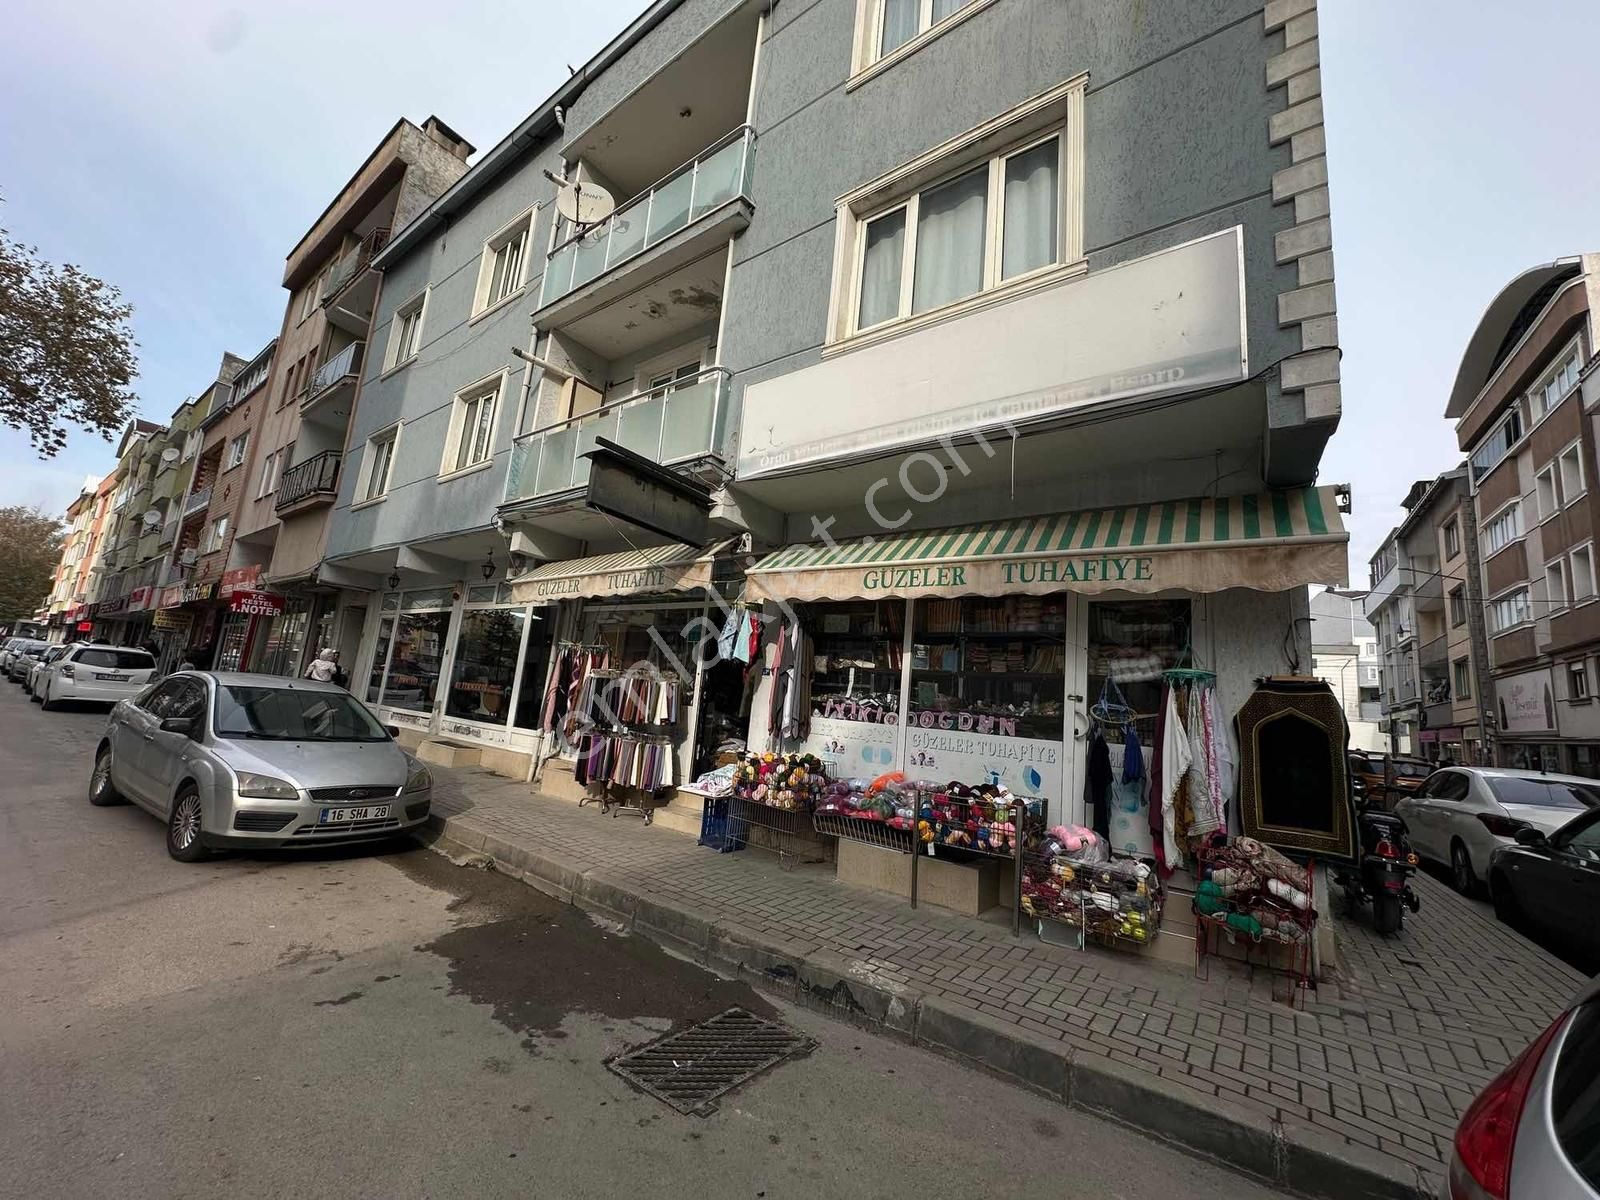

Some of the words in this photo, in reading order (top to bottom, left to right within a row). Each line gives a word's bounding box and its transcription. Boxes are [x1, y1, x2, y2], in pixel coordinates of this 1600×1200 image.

[863, 566, 967, 589] GÜZELER
[1002, 556, 1153, 584] TUHAFİYE
[241, 598, 273, 607] KESTEL
[251, 593, 266, 601] T.C.
[231, 602, 281, 617] 1.NOTER
[912, 732, 973, 755] GÜZELER
[332, 809, 344, 820] 16
[350, 808, 368, 819] SHA
[374, 807, 386, 817] 28
